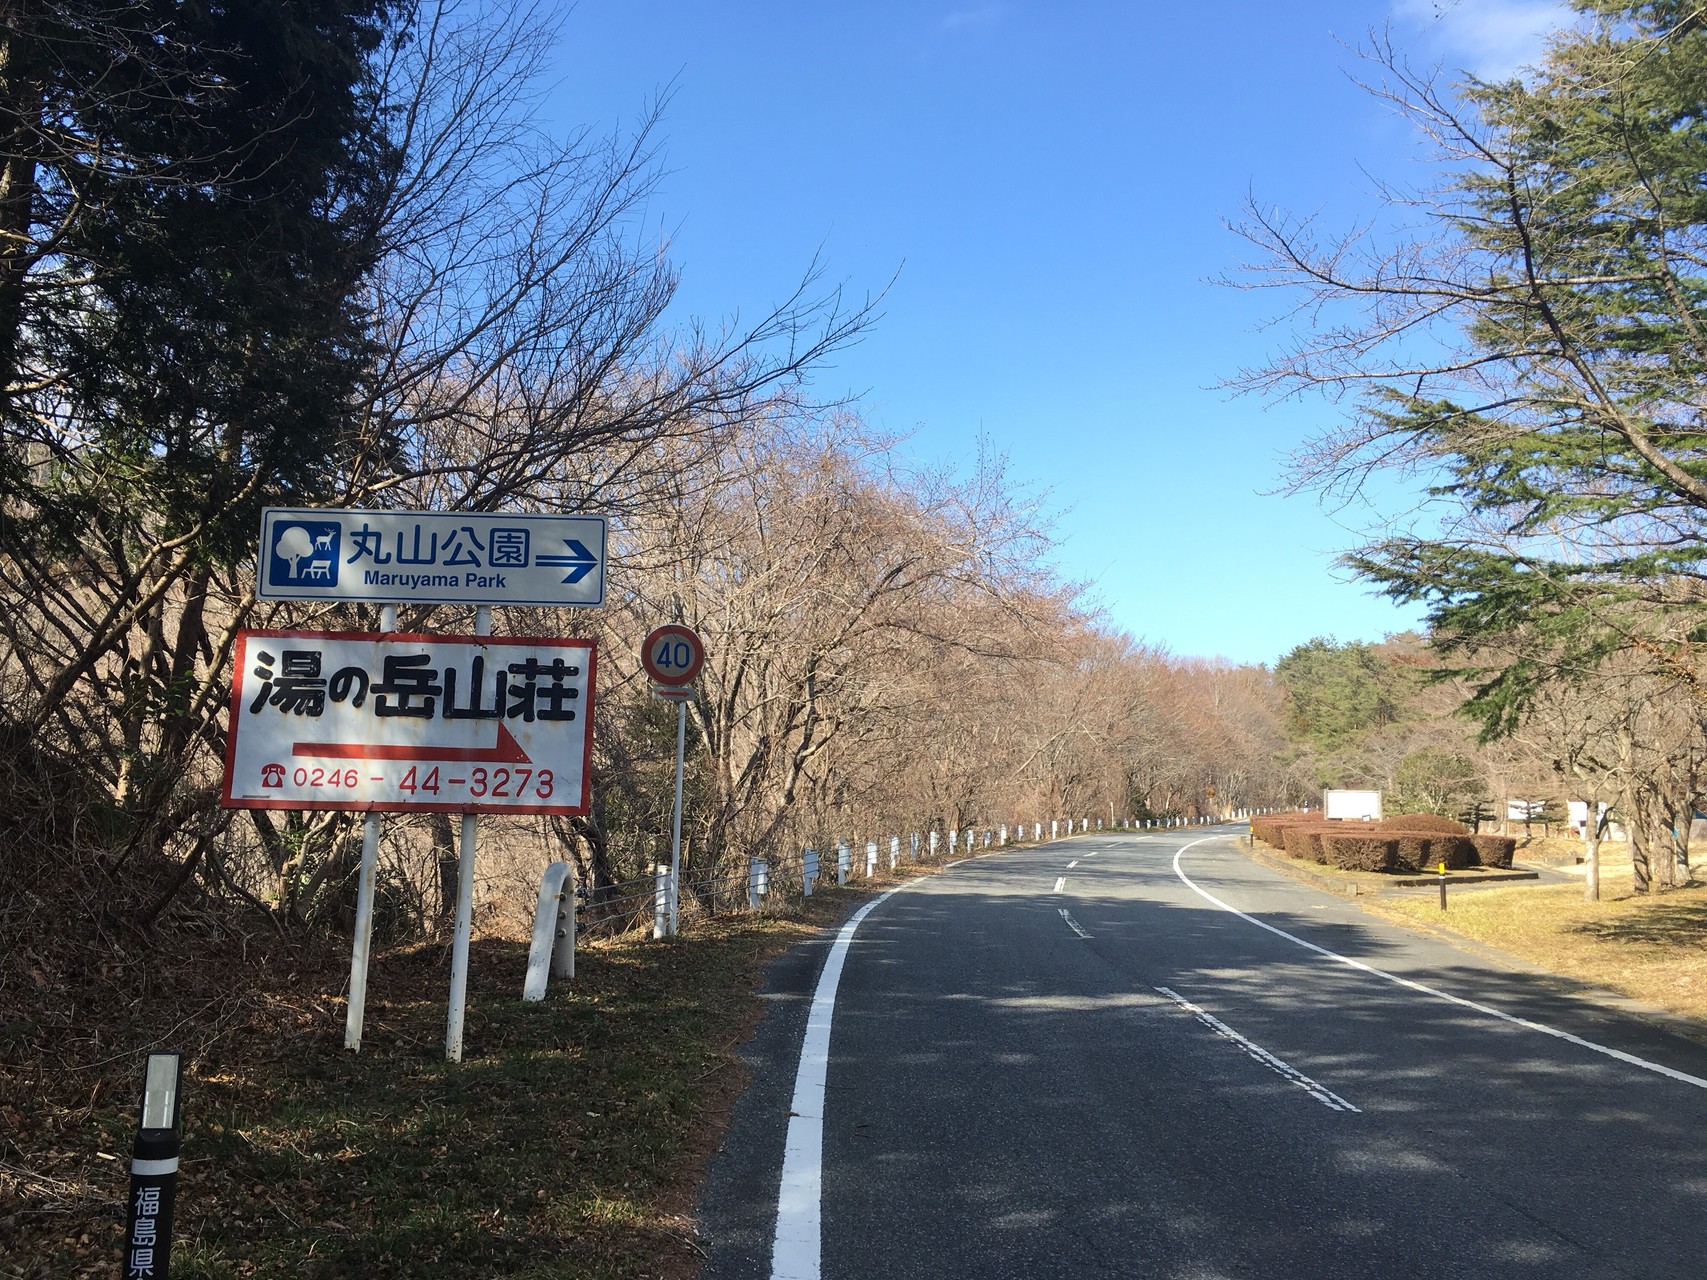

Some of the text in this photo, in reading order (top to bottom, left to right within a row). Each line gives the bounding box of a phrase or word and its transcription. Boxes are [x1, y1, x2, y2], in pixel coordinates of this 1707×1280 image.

[347, 523, 531, 568] 丸山公園
[364, 570, 506, 589] Maruyama Park
[656, 642, 690, 669] 40
[249, 650, 580, 722] 湯の岳山荘
[129, 1186, 161, 1278] 福島県
